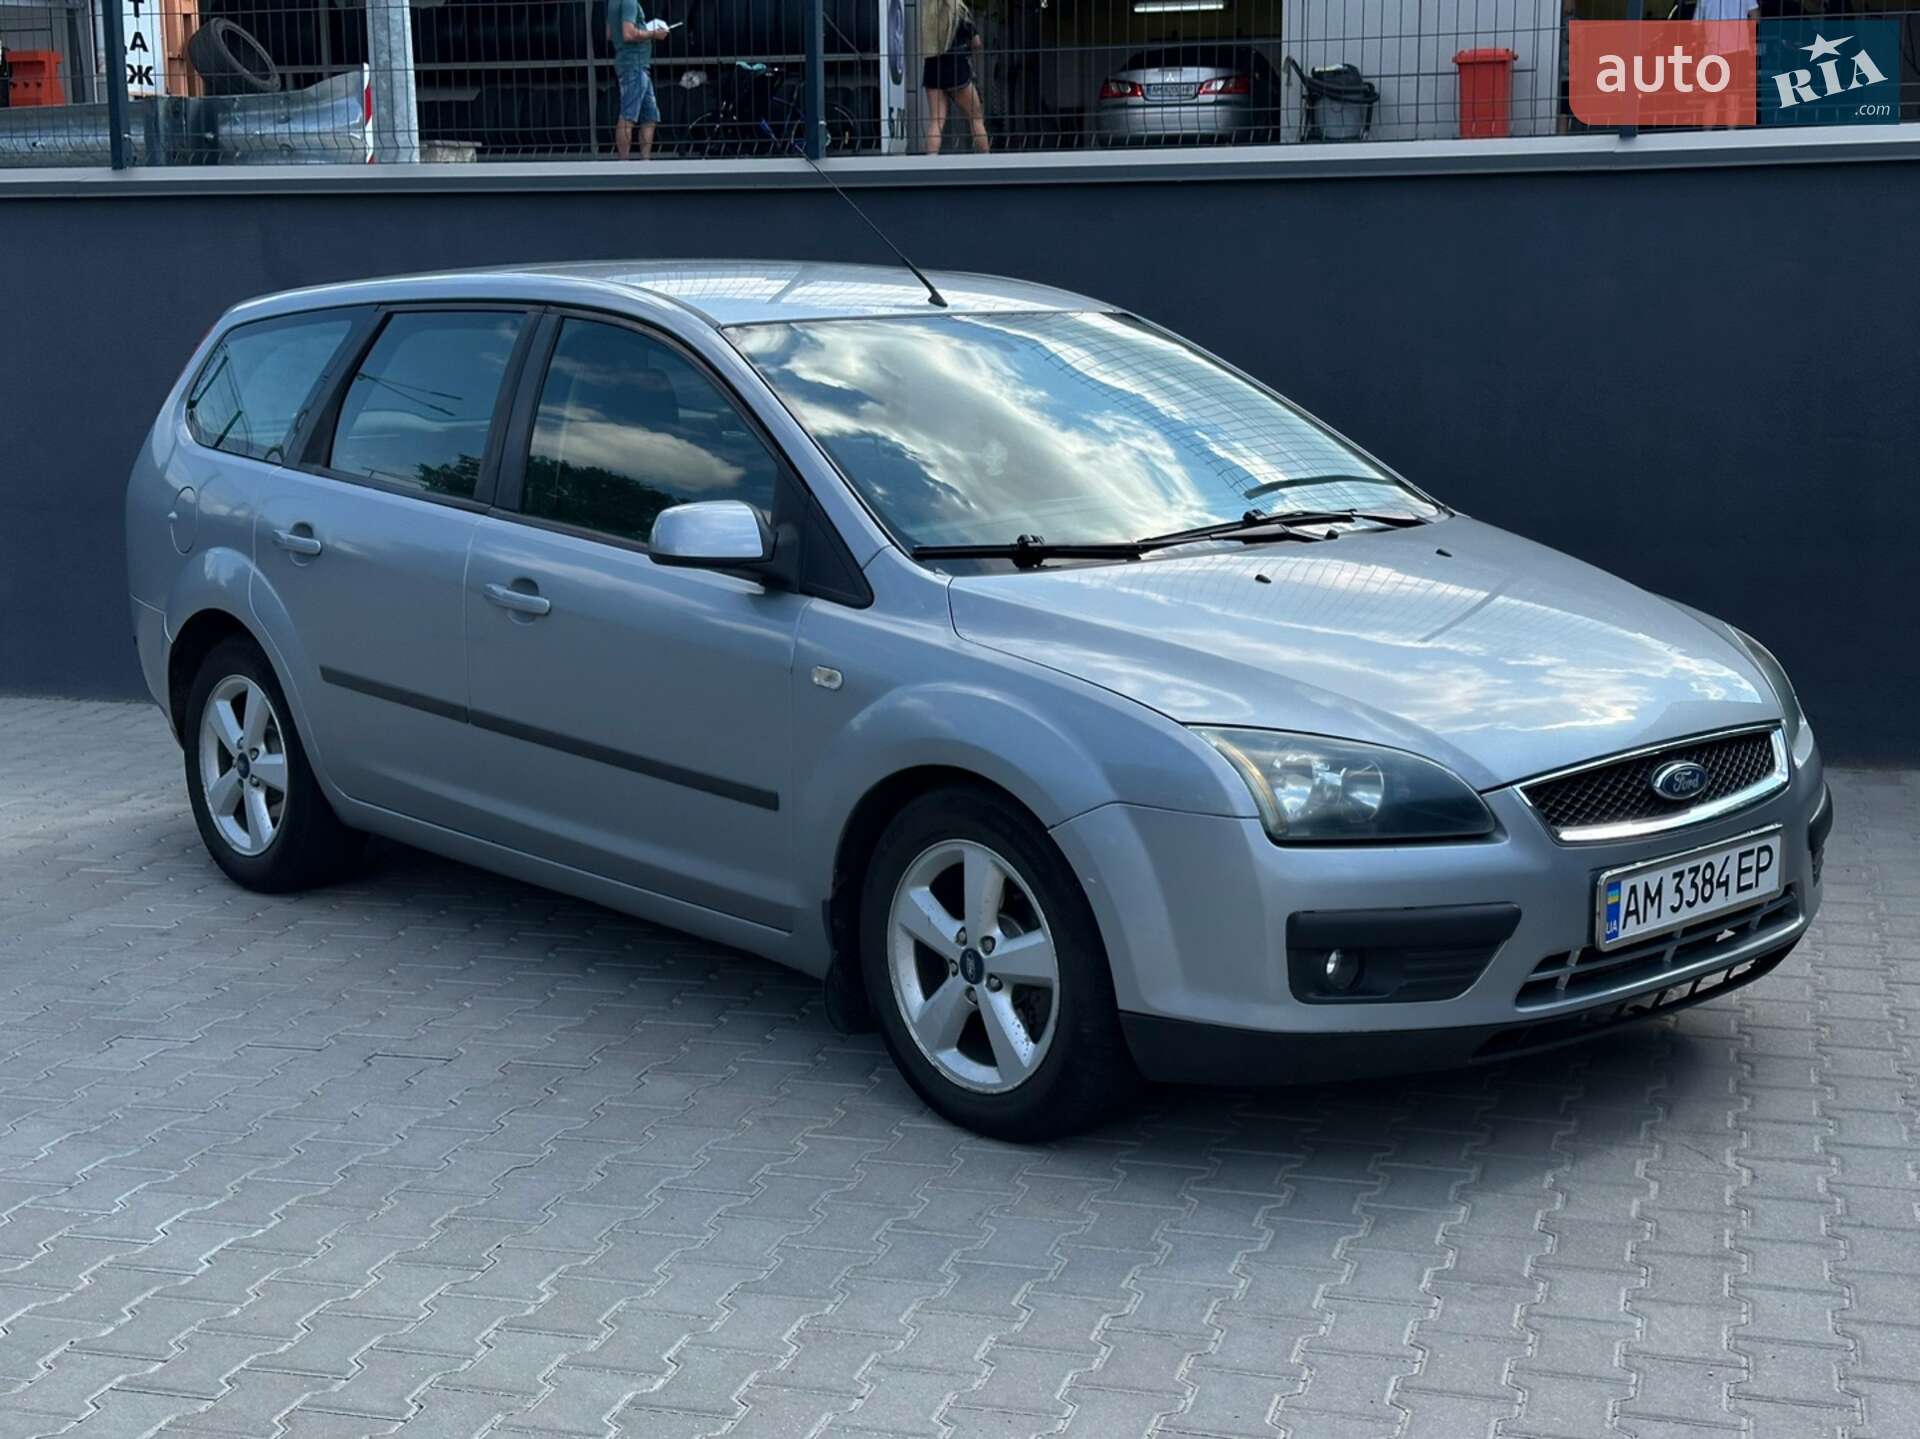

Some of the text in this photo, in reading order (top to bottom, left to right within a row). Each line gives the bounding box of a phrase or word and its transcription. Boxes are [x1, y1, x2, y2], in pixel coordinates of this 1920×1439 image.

[1672, 770, 1700, 793] Ford
[1622, 844, 1774, 930] AM 3384 EP
